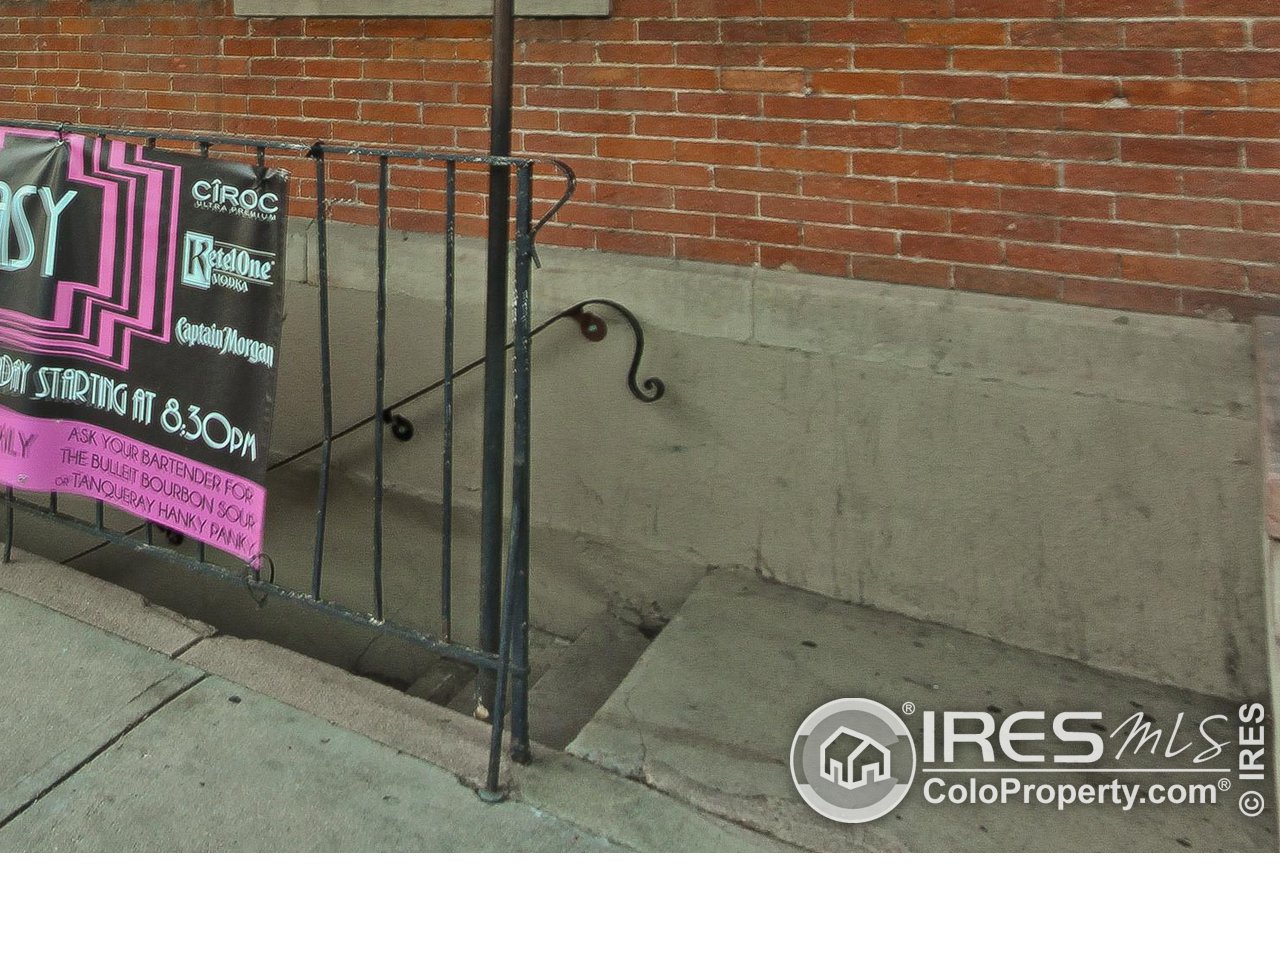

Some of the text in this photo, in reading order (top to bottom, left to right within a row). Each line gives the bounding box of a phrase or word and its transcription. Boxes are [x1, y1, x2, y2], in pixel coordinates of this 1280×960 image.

[231, 207, 277, 221] PREMIUM
[211, 272, 249, 292] VODKA
[175, 317, 274, 368] Captain Morgan
[35, 366, 127, 415] STARTING
[132, 388, 156, 425] AT
[160, 398, 257, 462] 8:30PM
[60, 448, 256, 529] THE BULLEIT BOURBON SOUR
[68, 427, 254, 504] ASK YOUR BARTENDER FOR
[70, 472, 155, 514] TANQUERAY
[158, 501, 207, 534] HANKY
